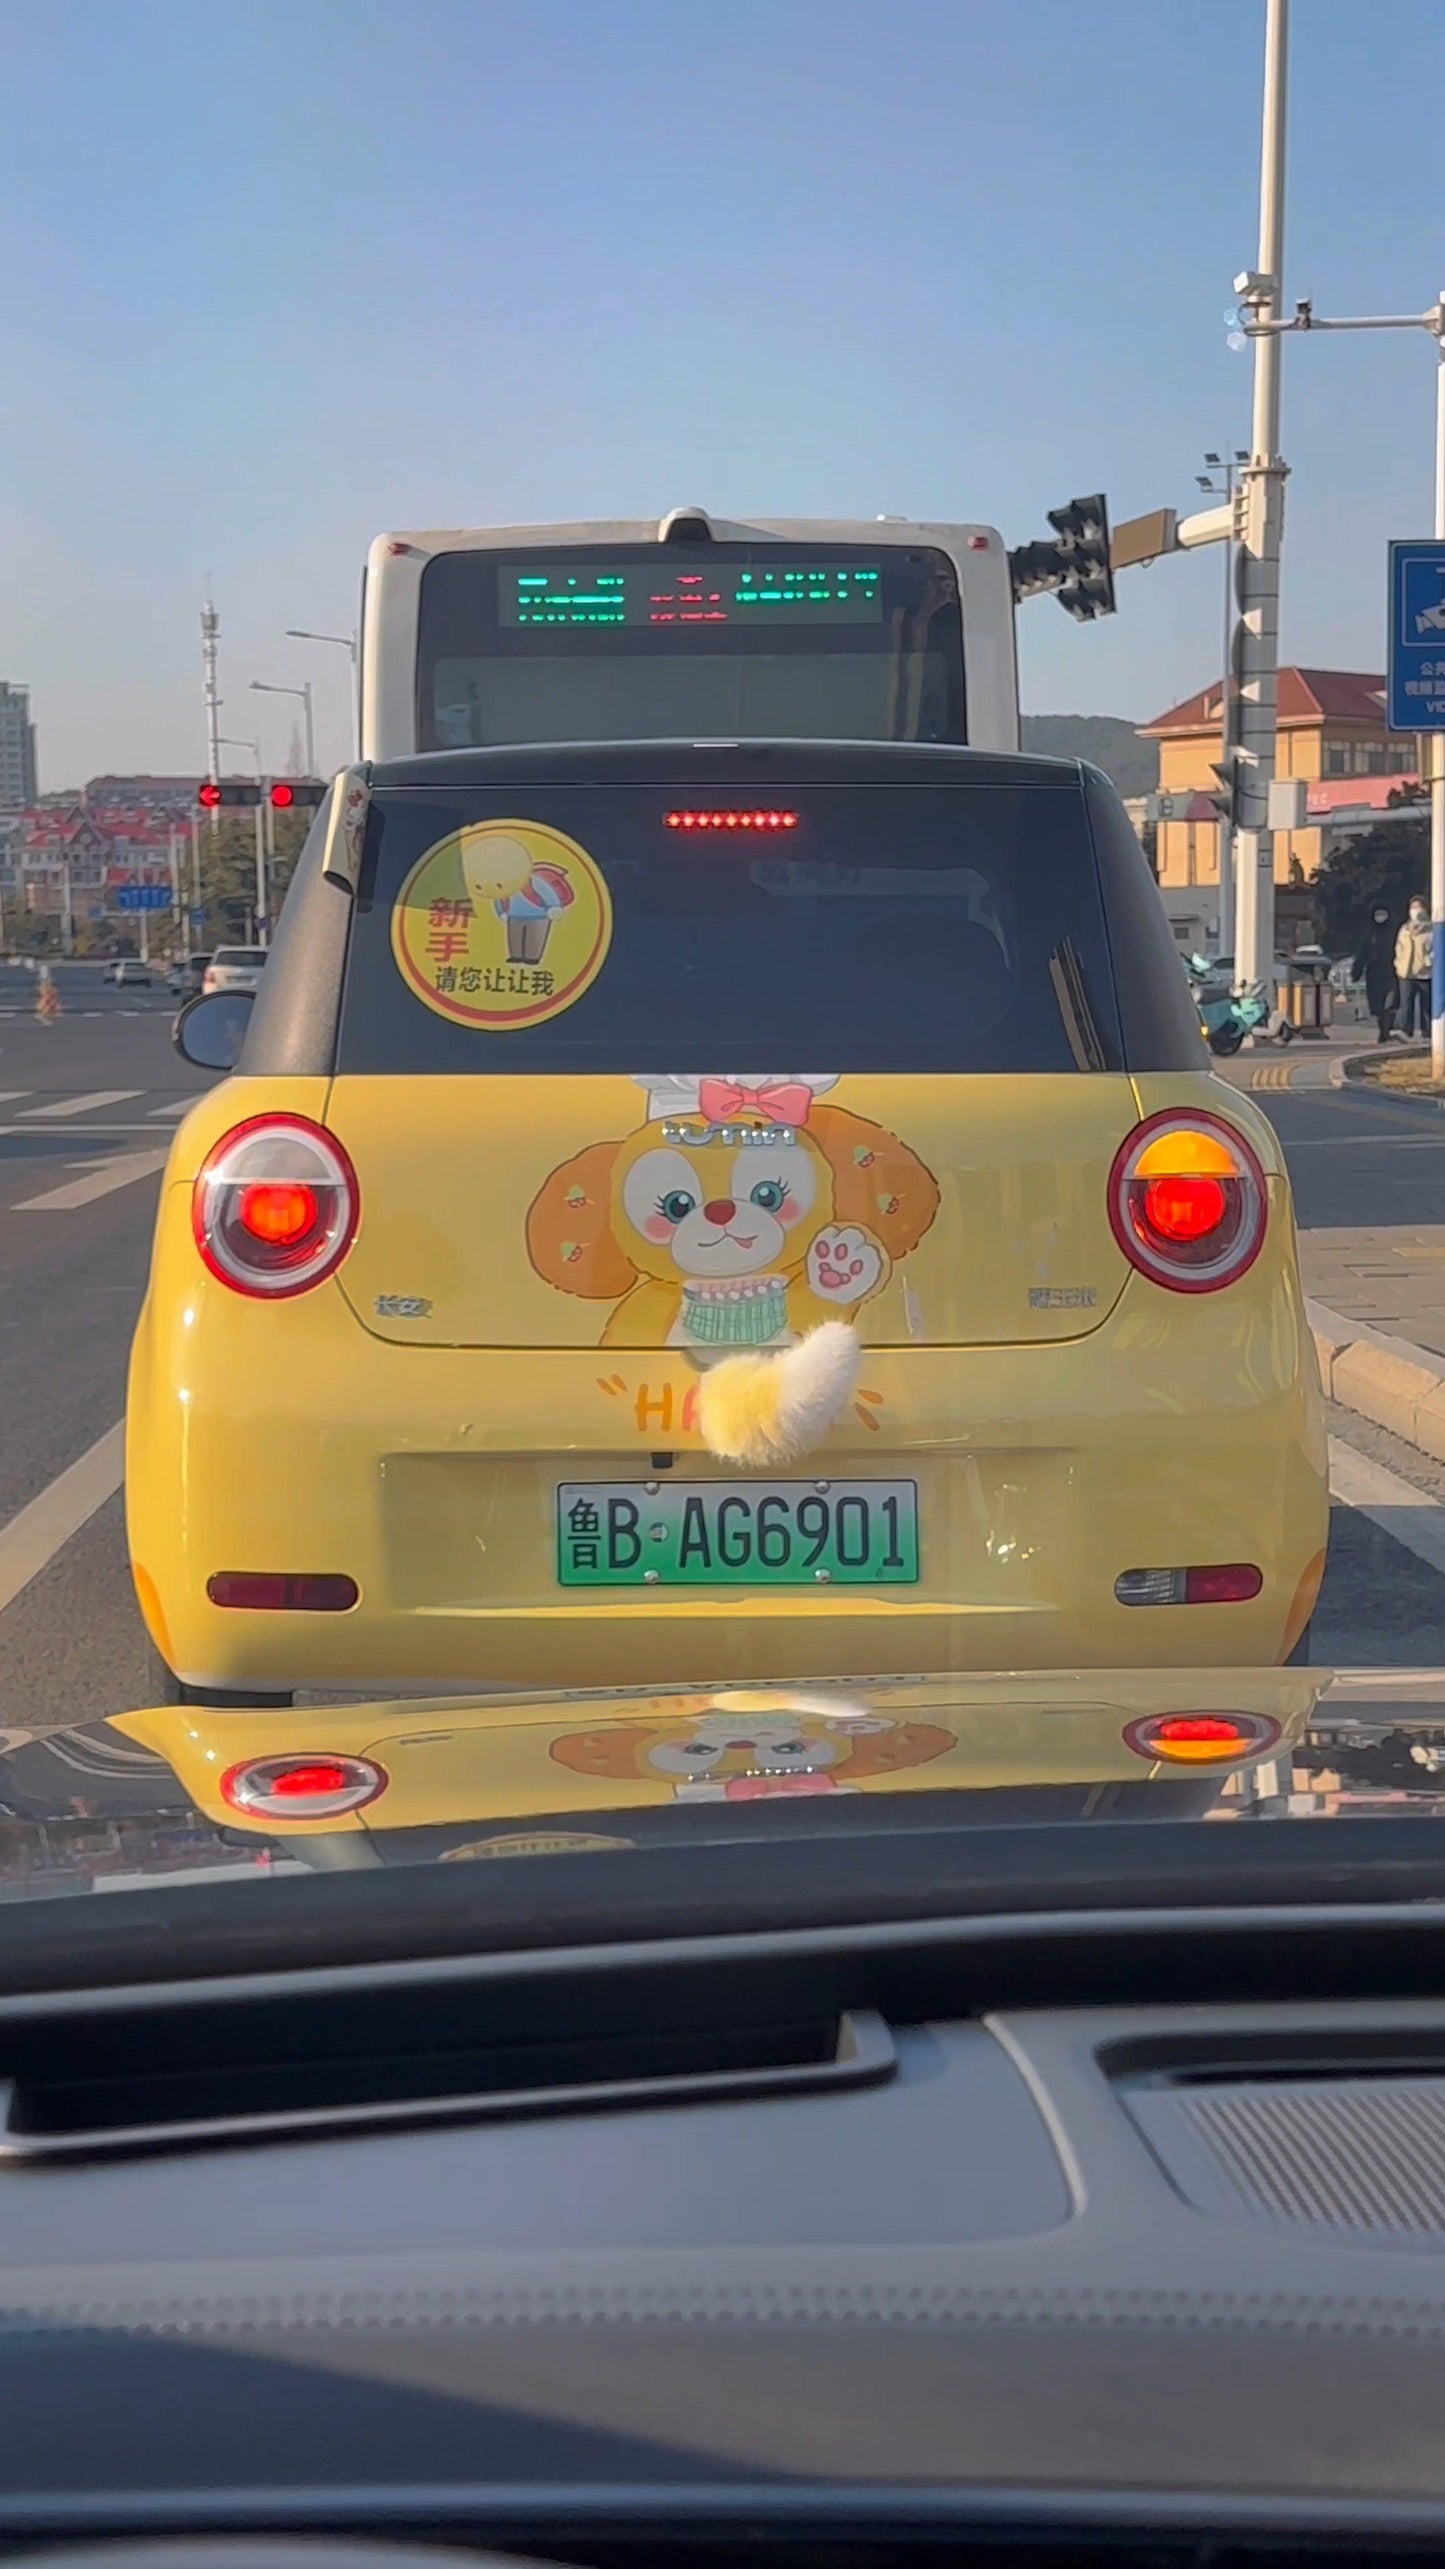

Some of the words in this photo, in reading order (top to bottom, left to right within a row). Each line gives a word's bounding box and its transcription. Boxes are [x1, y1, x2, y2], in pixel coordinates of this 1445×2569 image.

[425, 897, 473, 962] 新手
[435, 966, 555, 996] 请您让让我
